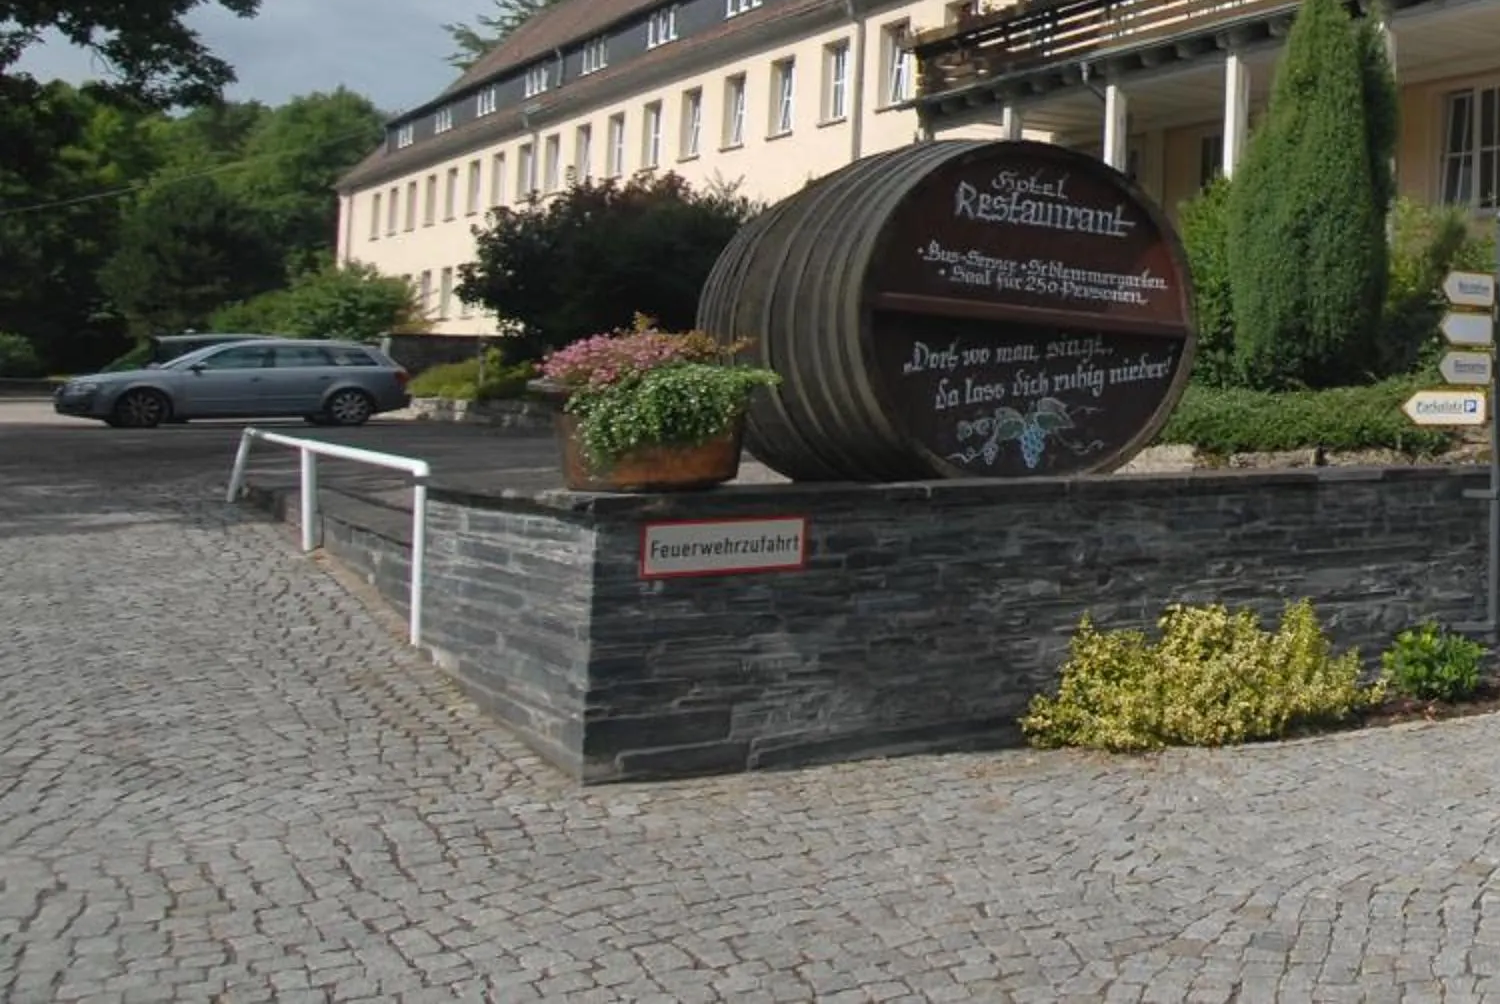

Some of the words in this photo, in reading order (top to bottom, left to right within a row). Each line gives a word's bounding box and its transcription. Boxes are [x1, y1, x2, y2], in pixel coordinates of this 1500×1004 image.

[991, 169, 1068, 199] Hotel
[1025, 276, 1059, 295] 250
[1054, 359, 1105, 398] ruhig
[650, 534, 800, 560] Feuerwehrzufahrt
